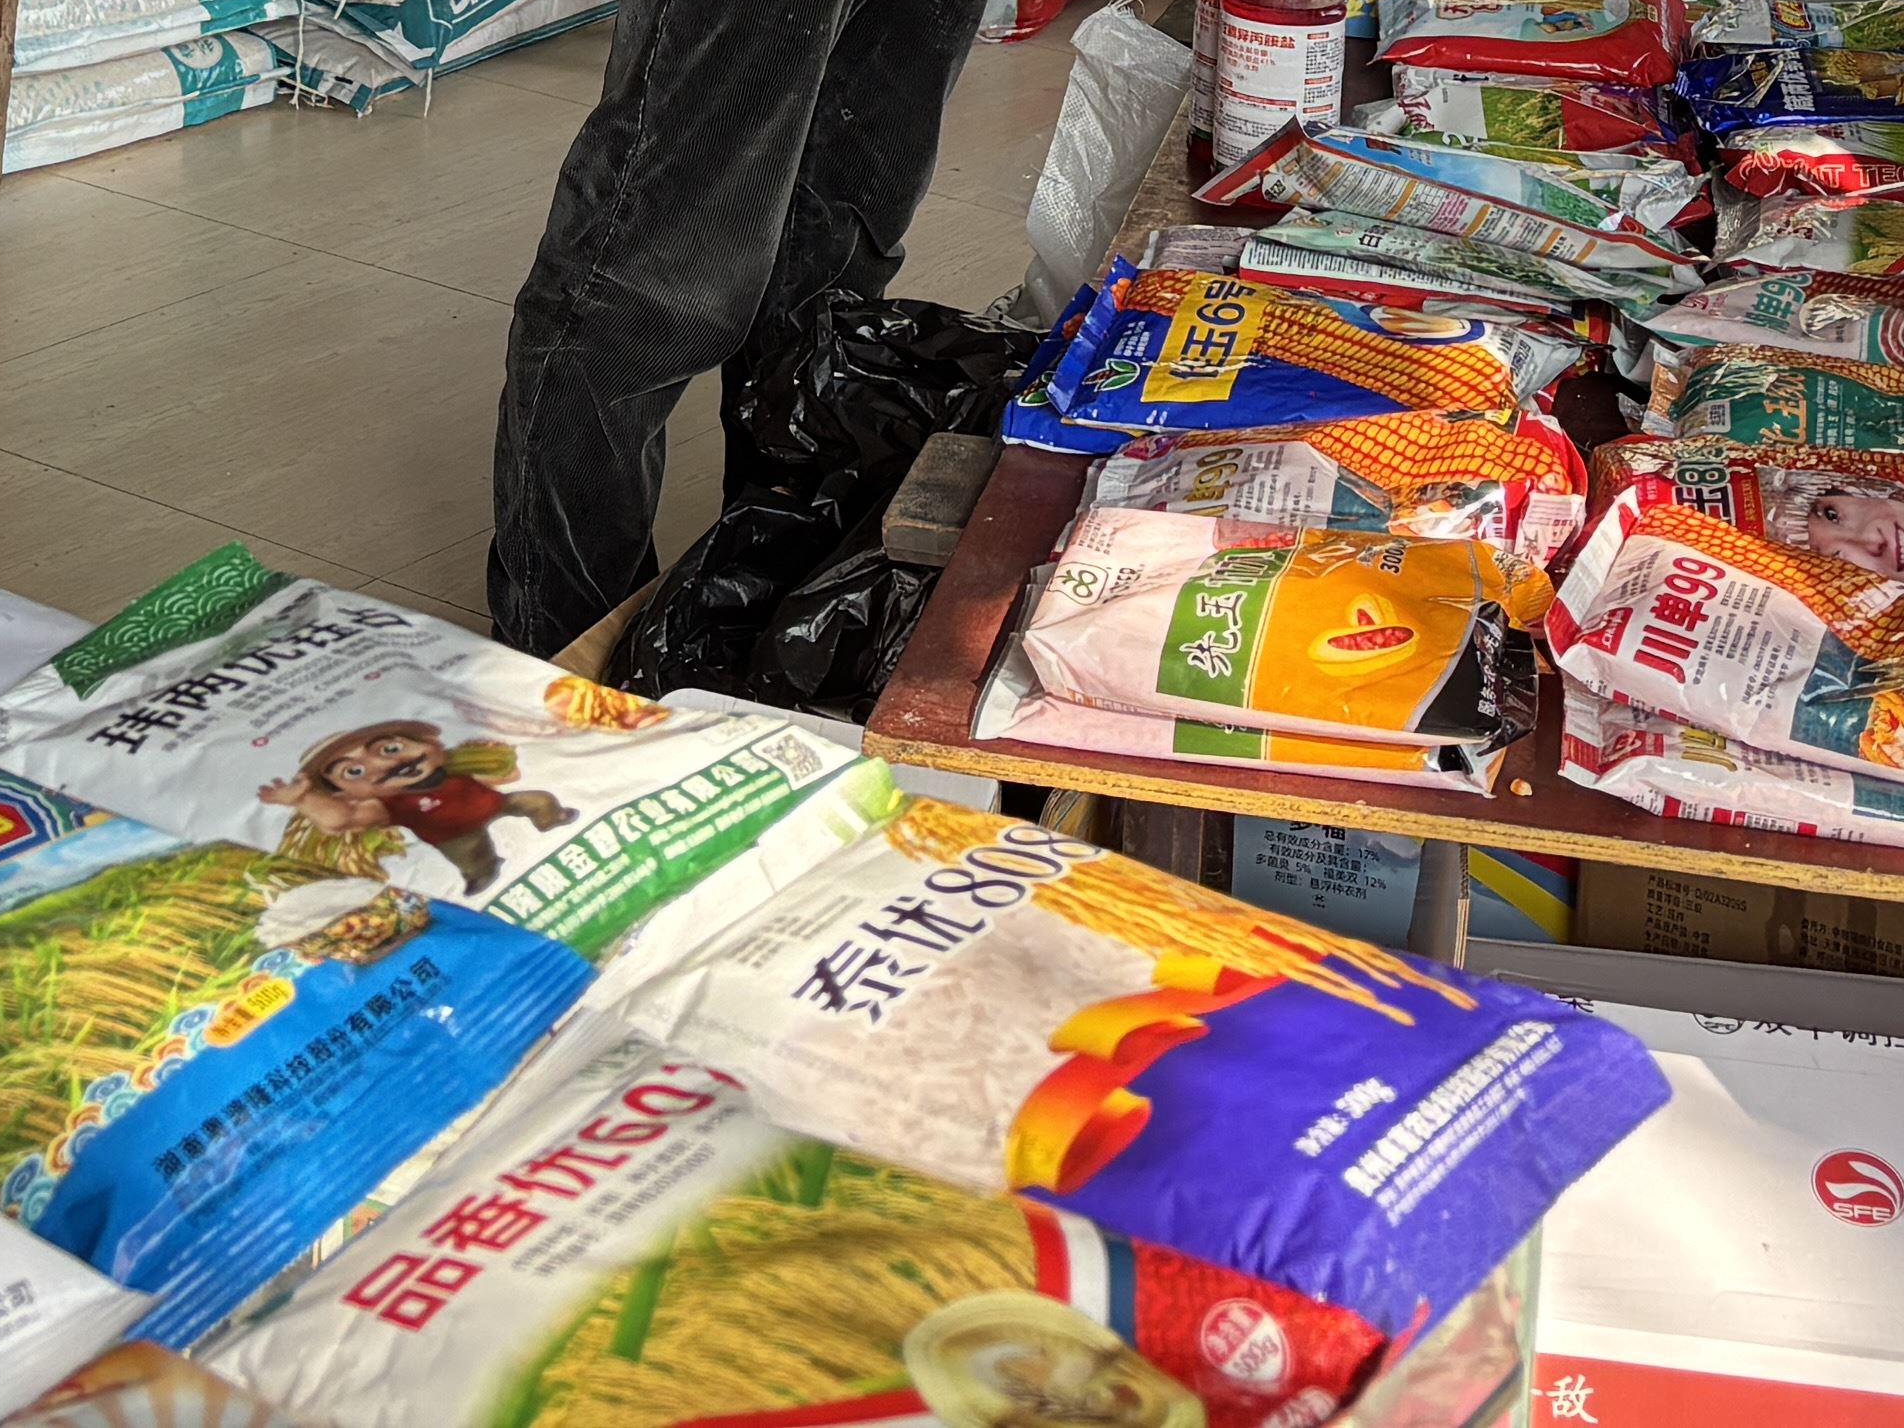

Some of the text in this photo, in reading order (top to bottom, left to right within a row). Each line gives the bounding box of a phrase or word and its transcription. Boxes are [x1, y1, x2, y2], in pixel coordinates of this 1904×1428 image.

[1633, 554, 1728, 685] 川单99
[1264, 830, 1381, 863] 总有效成分含量： 17%
[1269, 844, 1368, 874] 有效成分及其含量：
[1255, 853, 1290, 872] 多菌灵
[1295, 862, 1312, 875] 5%
[1364, 876, 1388, 891] 12%
[790, 825, 1102, 1025] 泰优808
[1832, 1201, 1892, 1223] SFE
